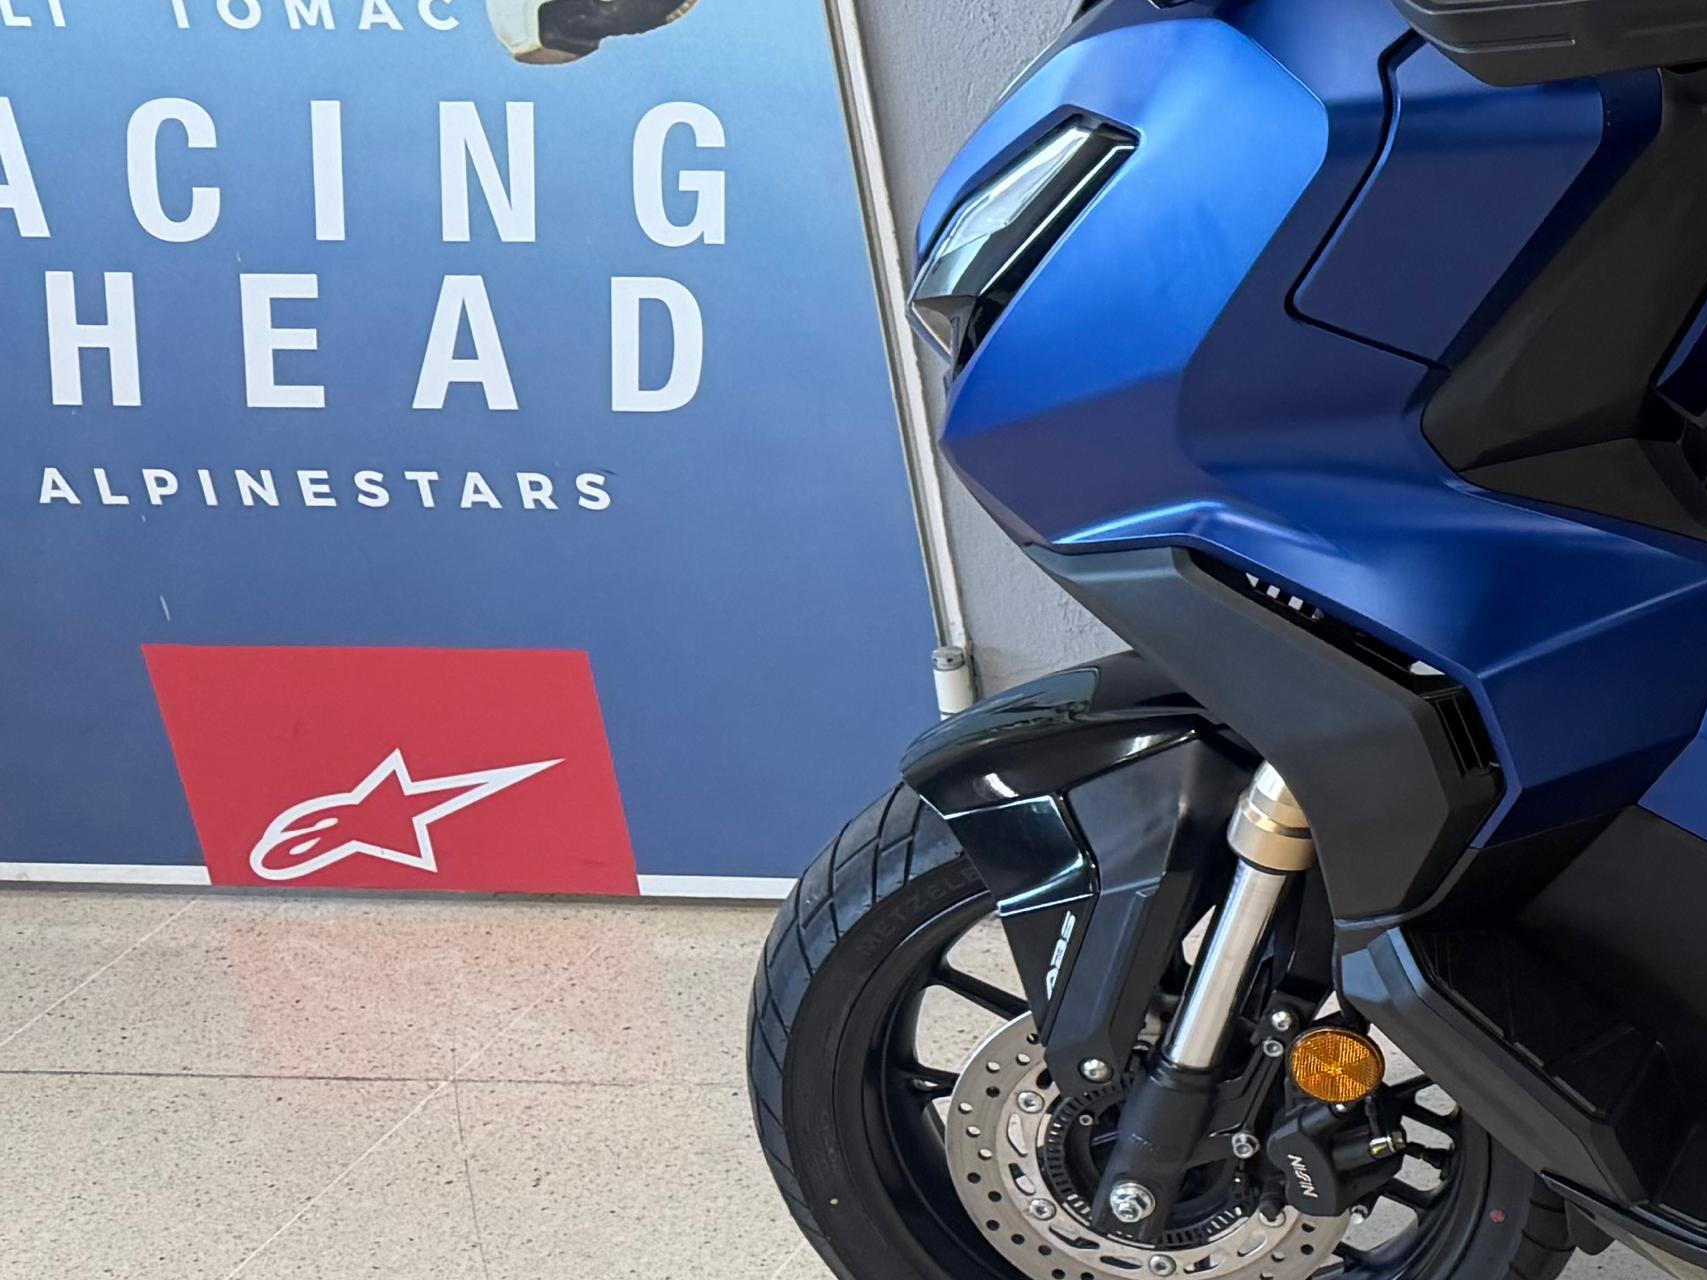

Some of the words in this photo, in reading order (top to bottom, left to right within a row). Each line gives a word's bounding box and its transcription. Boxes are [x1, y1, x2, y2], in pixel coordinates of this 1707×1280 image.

[44, 270, 706, 413] HEAD
[38, 466, 613, 511] ALPINESTARS
[1046, 910, 1076, 1001] ABS
